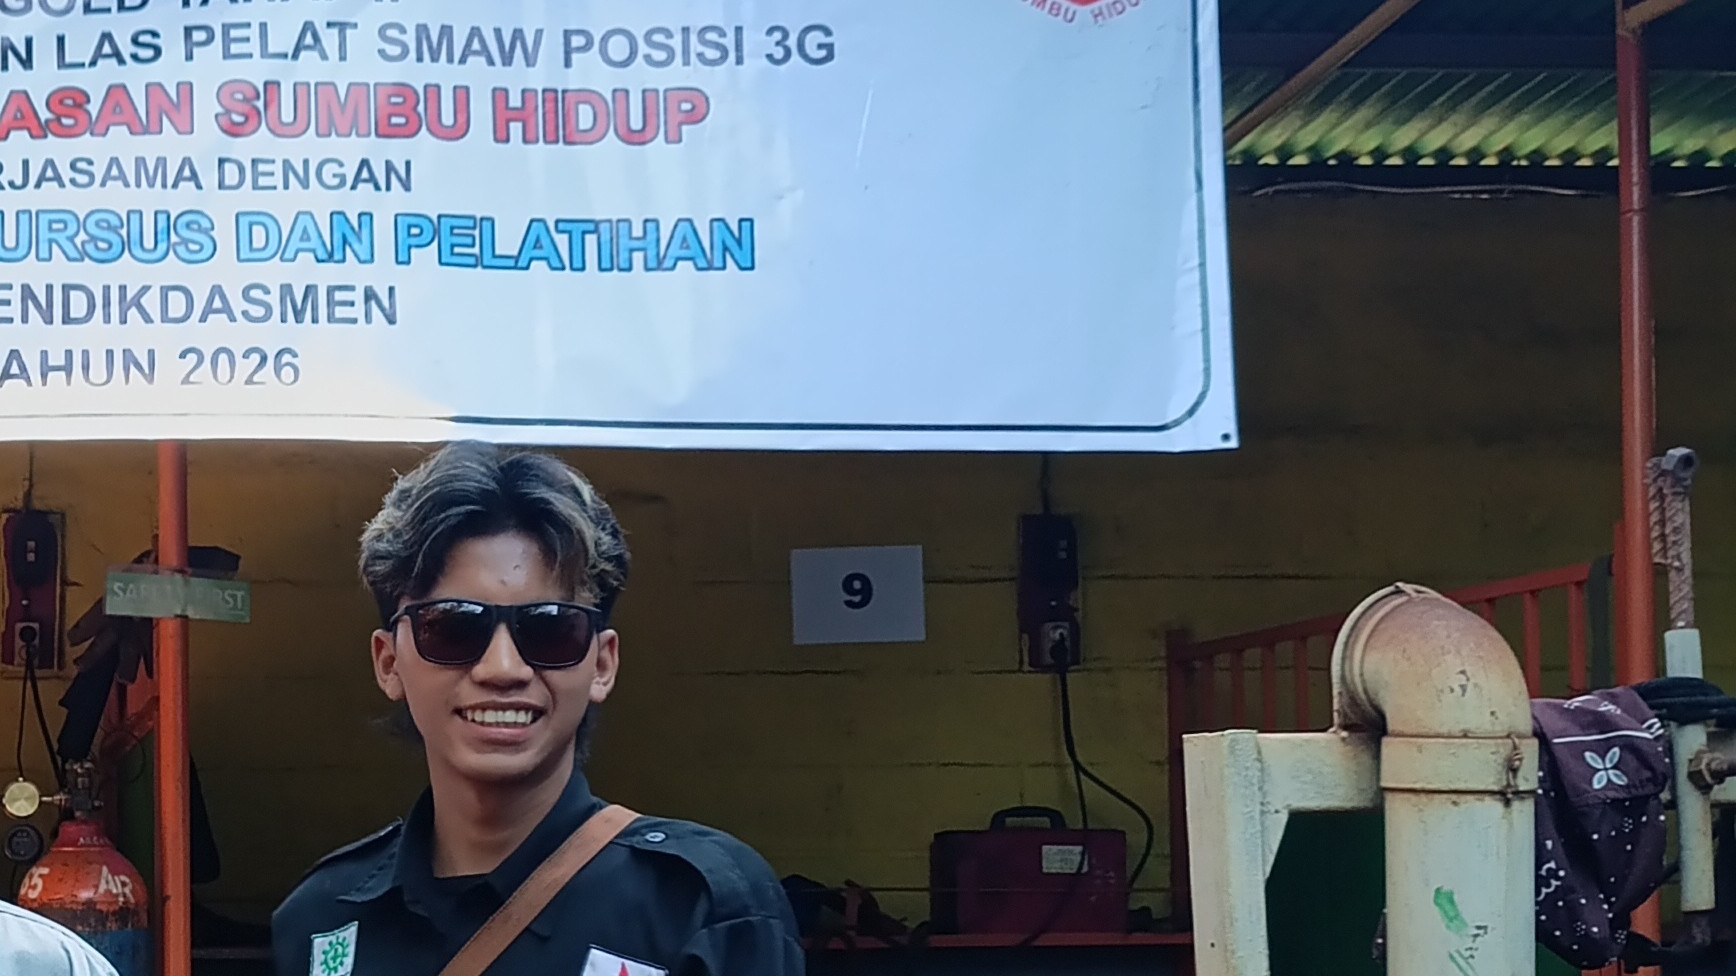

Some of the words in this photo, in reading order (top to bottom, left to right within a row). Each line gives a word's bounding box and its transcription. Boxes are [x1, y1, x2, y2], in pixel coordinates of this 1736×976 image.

[55, 29, 163, 71] LAS
[183, 20, 359, 62] PELAT
[377, 22, 545, 68] SMAW
[563, 25, 745, 69] POSISI
[764, 24, 836, 67] 3G
[215, 79, 472, 142] SUMBU
[491, 87, 711, 147] HIDUP
[217, 157, 412, 193] DENGAN
[235, 210, 376, 265] DAN
[394, 213, 756, 274] PELATIHAN
[178, 346, 300, 387] 2026
[842, 572, 874, 611] 9
